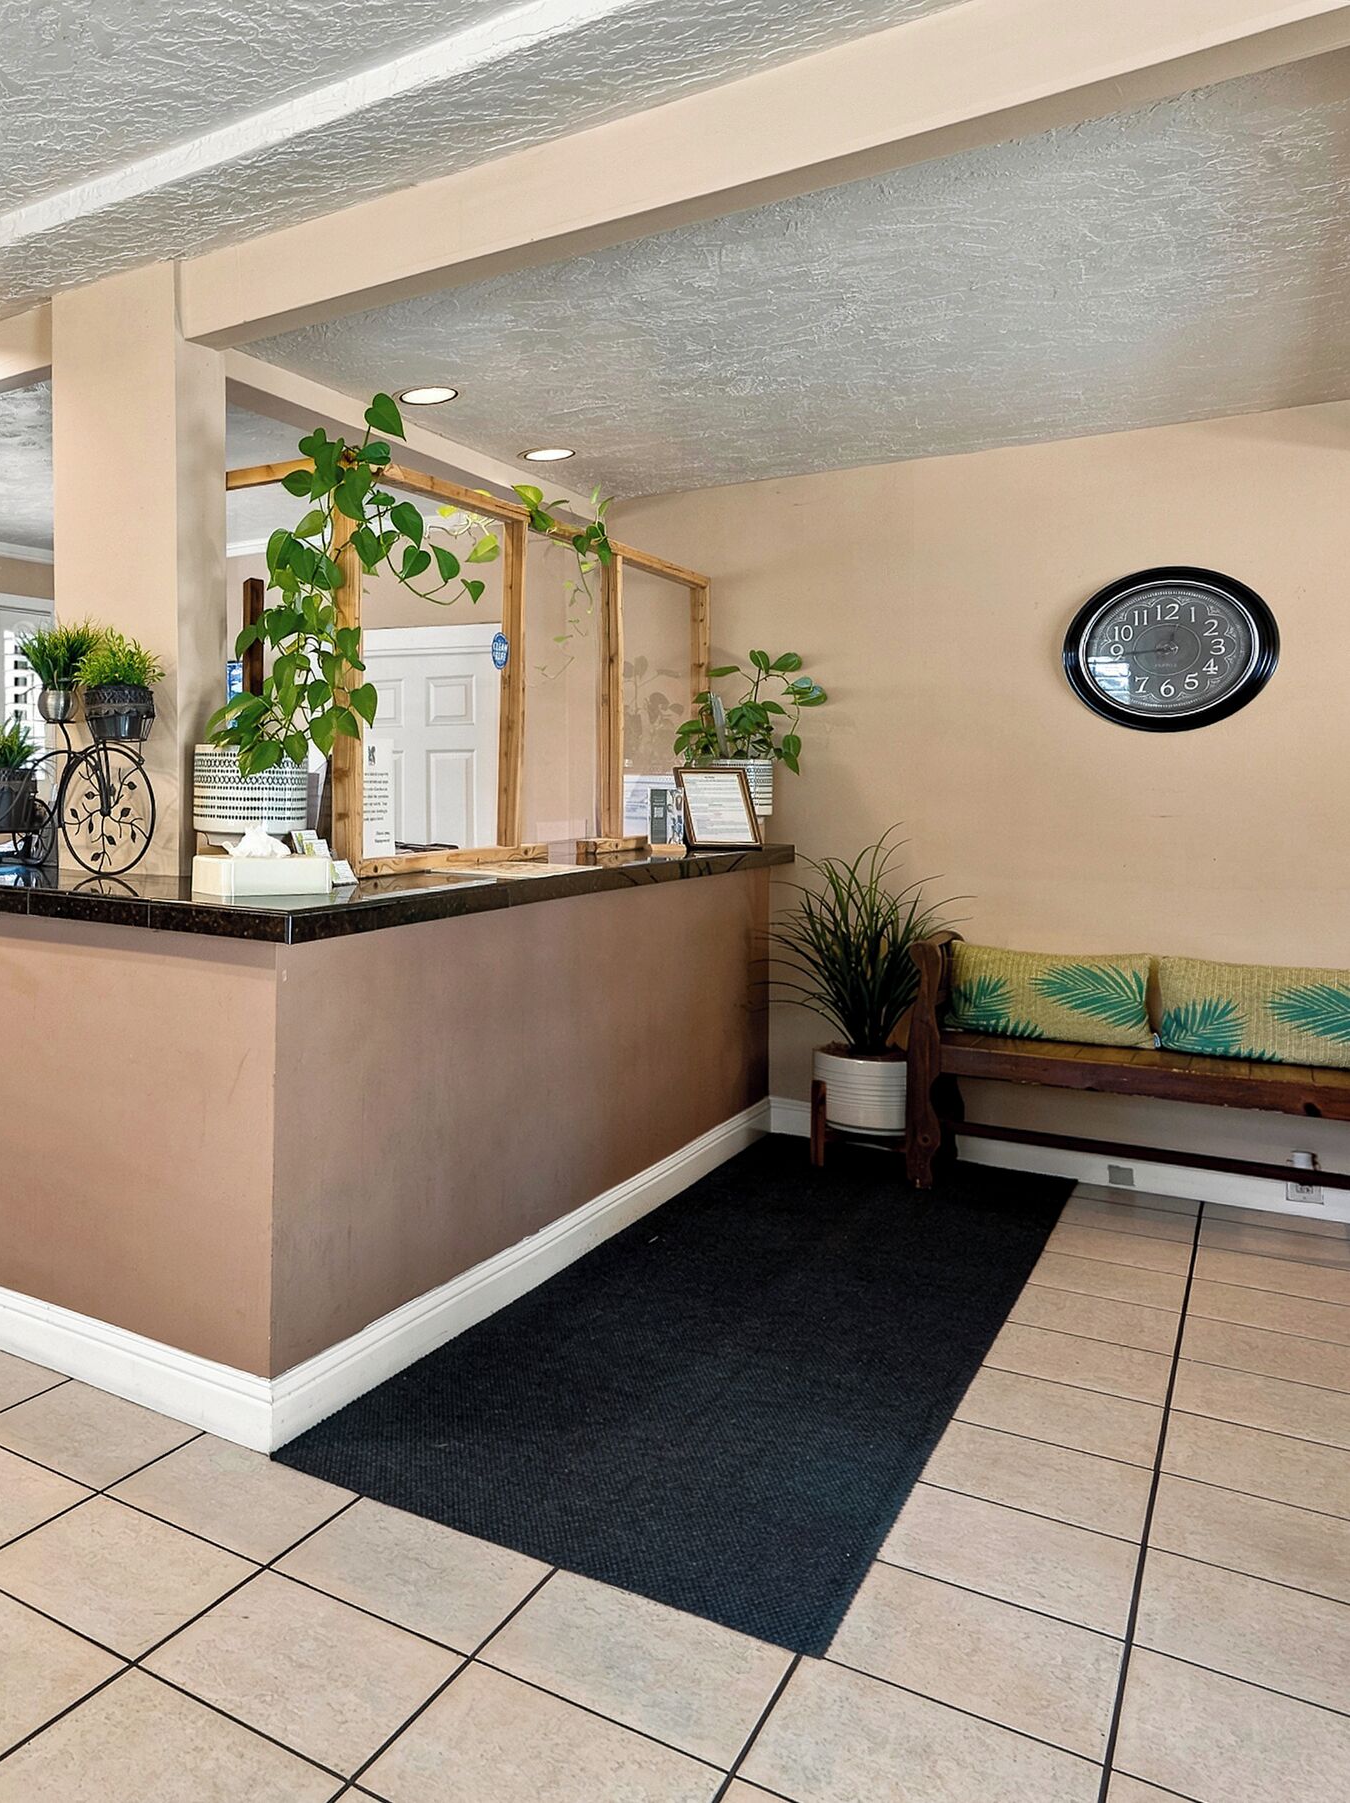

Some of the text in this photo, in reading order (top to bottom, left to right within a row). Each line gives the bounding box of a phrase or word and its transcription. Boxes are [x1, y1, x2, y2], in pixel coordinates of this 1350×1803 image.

[1133, 609, 1148, 626] 11
[1156, 604, 1179, 621] 12
[1190, 607, 1196, 622] 1
[1114, 625, 1133, 642] 10
[1203, 619, 1219, 637] 2
[493, 641, 508, 652] CLEAN
[1110, 643, 1125, 661] 9
[1210, 638, 1226, 655] 3
[1202, 658, 1219, 675] 4
[1134, 676, 1150, 694] 7
[1160, 679, 1175, 698] 6
[1184, 672, 1199, 690] 5
